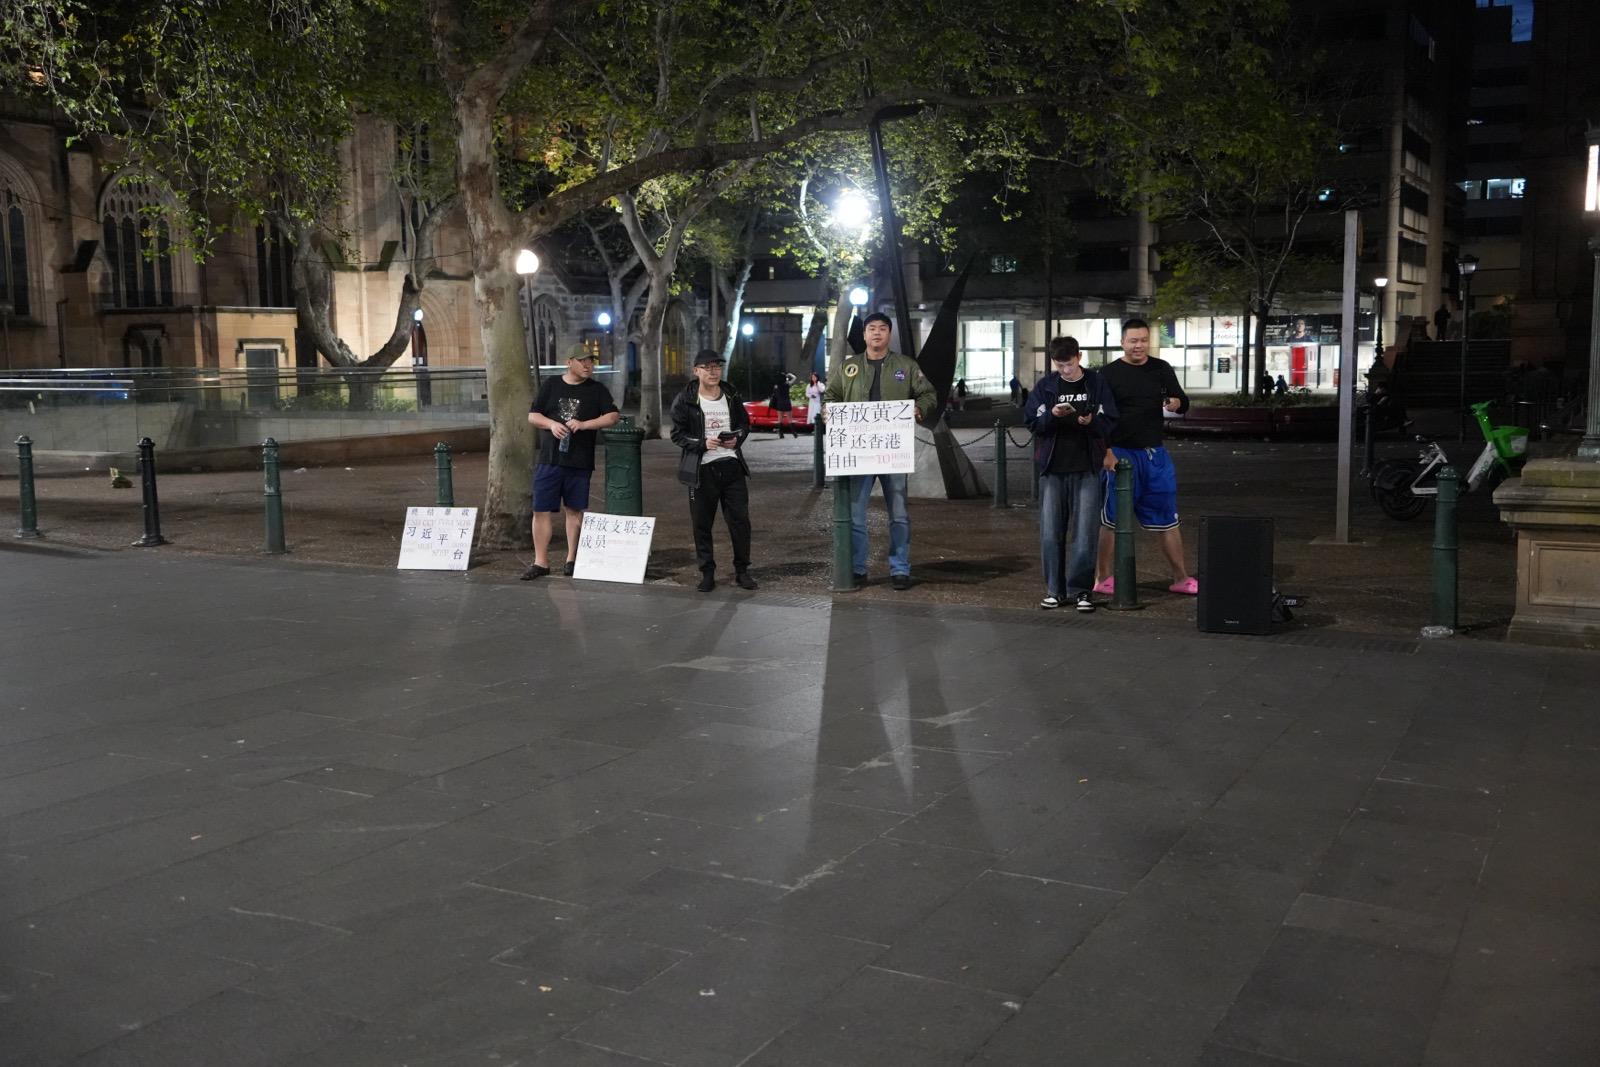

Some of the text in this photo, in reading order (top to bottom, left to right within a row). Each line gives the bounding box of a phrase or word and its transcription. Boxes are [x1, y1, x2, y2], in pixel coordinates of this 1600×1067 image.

[1058, 393, 1087, 402] 917.89
[827, 402, 912, 425] 释放黄之
[828, 427, 901, 449] 锋还香港
[828, 451, 857, 469] 自由
[583, 515, 651, 536] 释放支联会
[581, 534, 606, 549] 成员
